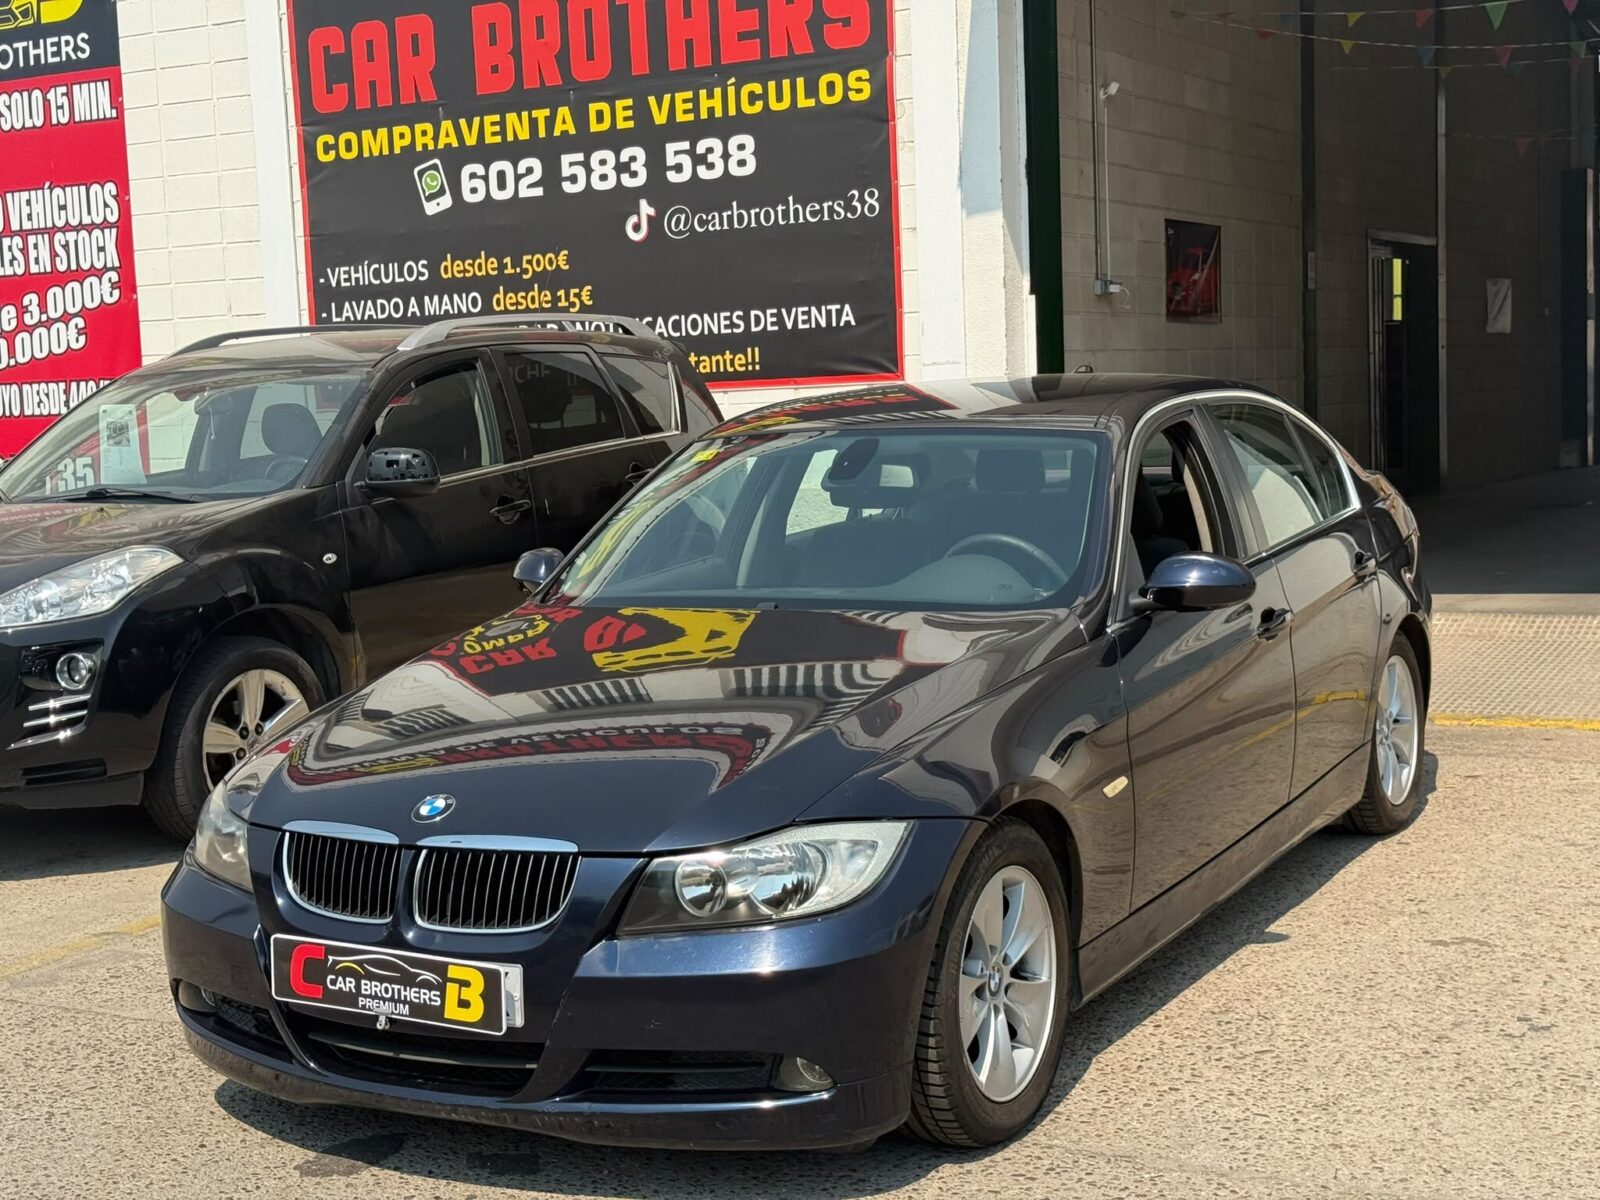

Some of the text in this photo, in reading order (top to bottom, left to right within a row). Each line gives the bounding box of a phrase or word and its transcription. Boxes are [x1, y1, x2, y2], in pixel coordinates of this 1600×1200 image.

[308, 0, 870, 114] CAR BROTHERS
[0, 80, 118, 130] SOLO 15 MIN.
[316, 69, 871, 163] COMPRAVENTA DE VEHÍCULOS
[461, 134, 757, 203] 602 583 538
[6, 181, 120, 232] VEHÍCULOS
[664, 188, 880, 239] @carbrothers38
[27, 233, 52, 275] EN
[53, 227, 121, 273] STOCK
[327, 260, 429, 288] VEHÍCULOS
[440, 250, 498, 279] desde
[503, 250, 569, 279] 1.500€
[22, 270, 121, 326] 3.000€
[331, 298, 404, 322] LAVADO
[407, 297, 420, 317] A
[424, 291, 482, 316] MANO
[492, 283, 552, 311] desde
[556, 285, 593, 313] 15€
[750, 308, 779, 332] DE
[781, 303, 856, 330] VENTA
[22, 382, 68, 416] DESDE
[289, 943, 325, 998] C
[326, 975, 441, 1006] CAR BROTHERS
[358, 997, 410, 1016] PREMIUM
